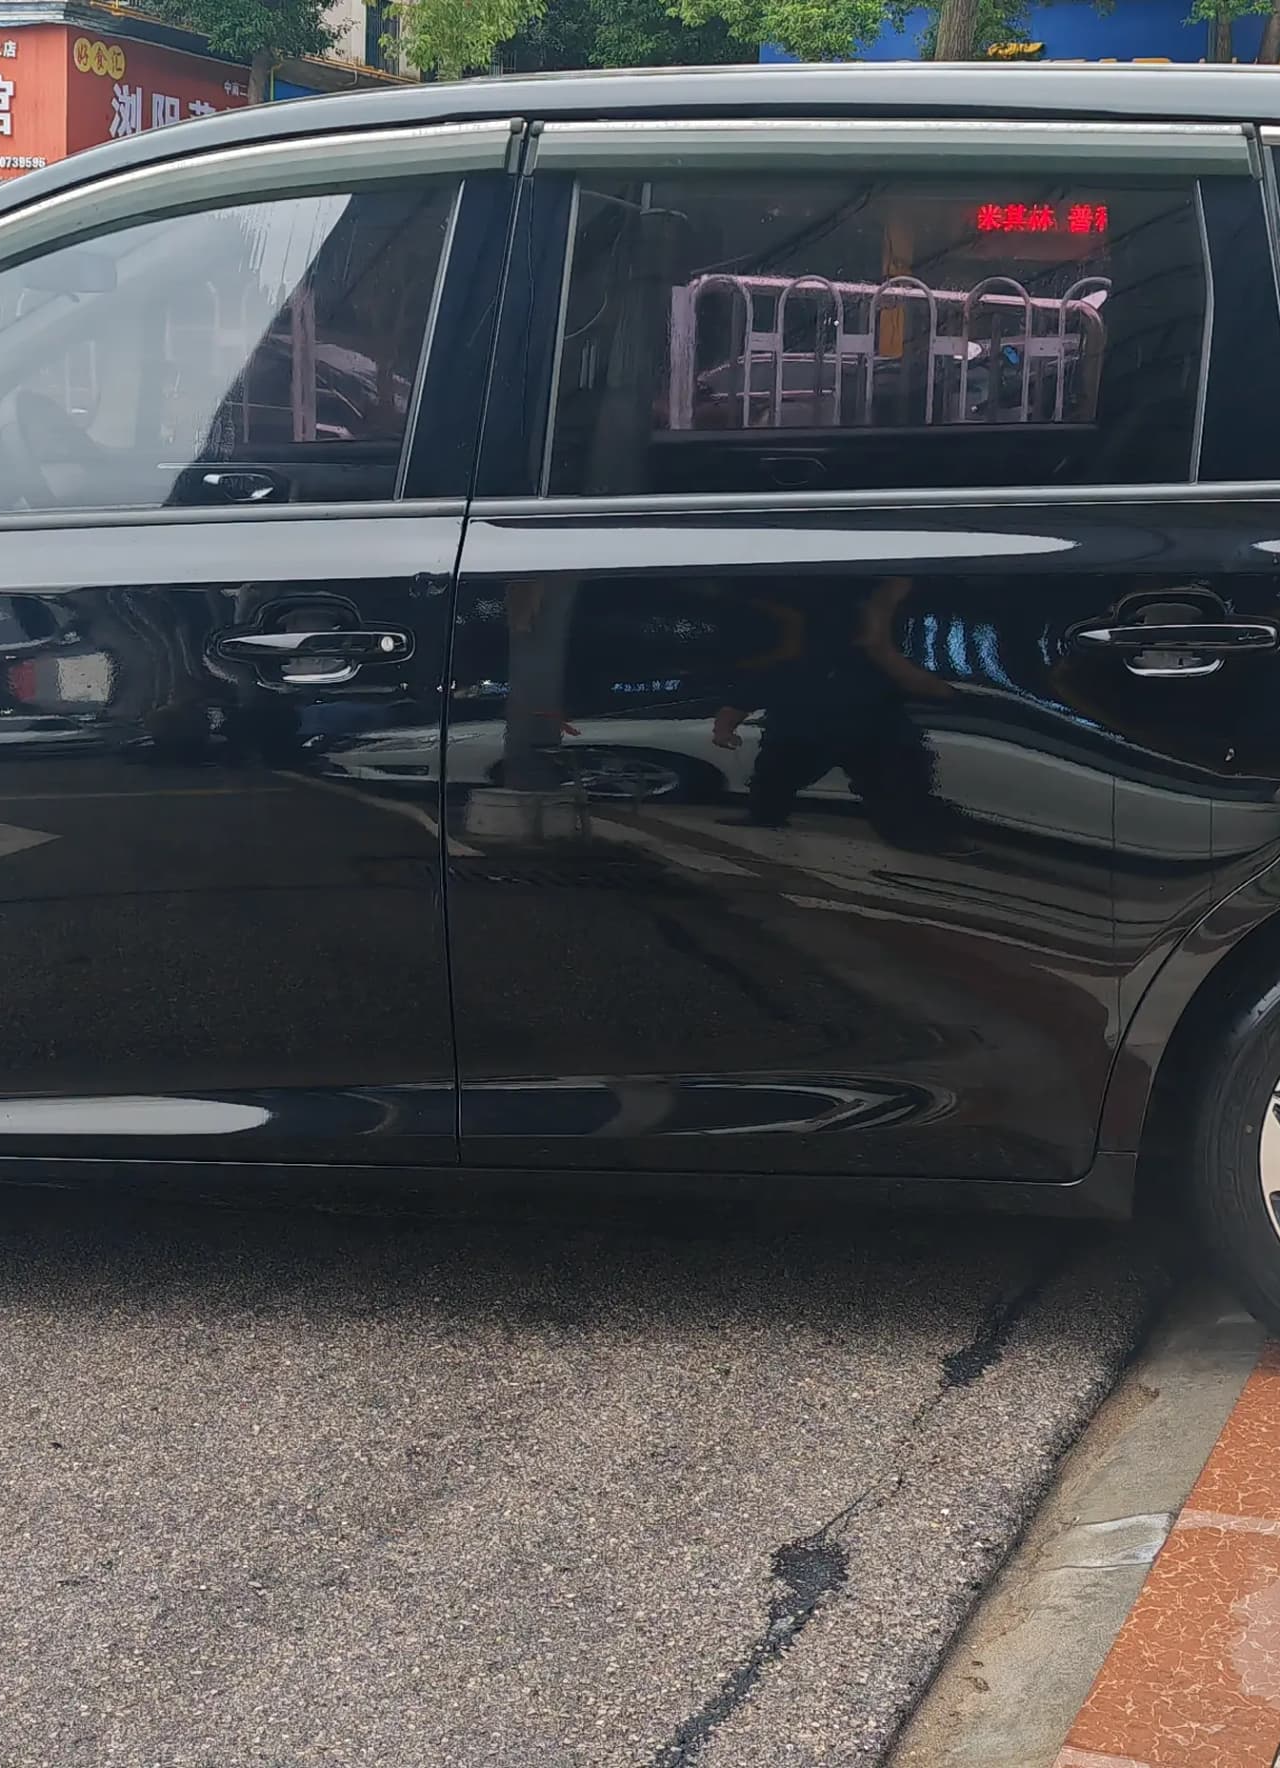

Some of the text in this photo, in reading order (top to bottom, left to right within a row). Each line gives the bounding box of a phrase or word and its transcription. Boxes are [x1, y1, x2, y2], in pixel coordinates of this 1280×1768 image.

[76, 42, 124, 74] 好食汇
[977, 204, 1056, 232] 米其林
